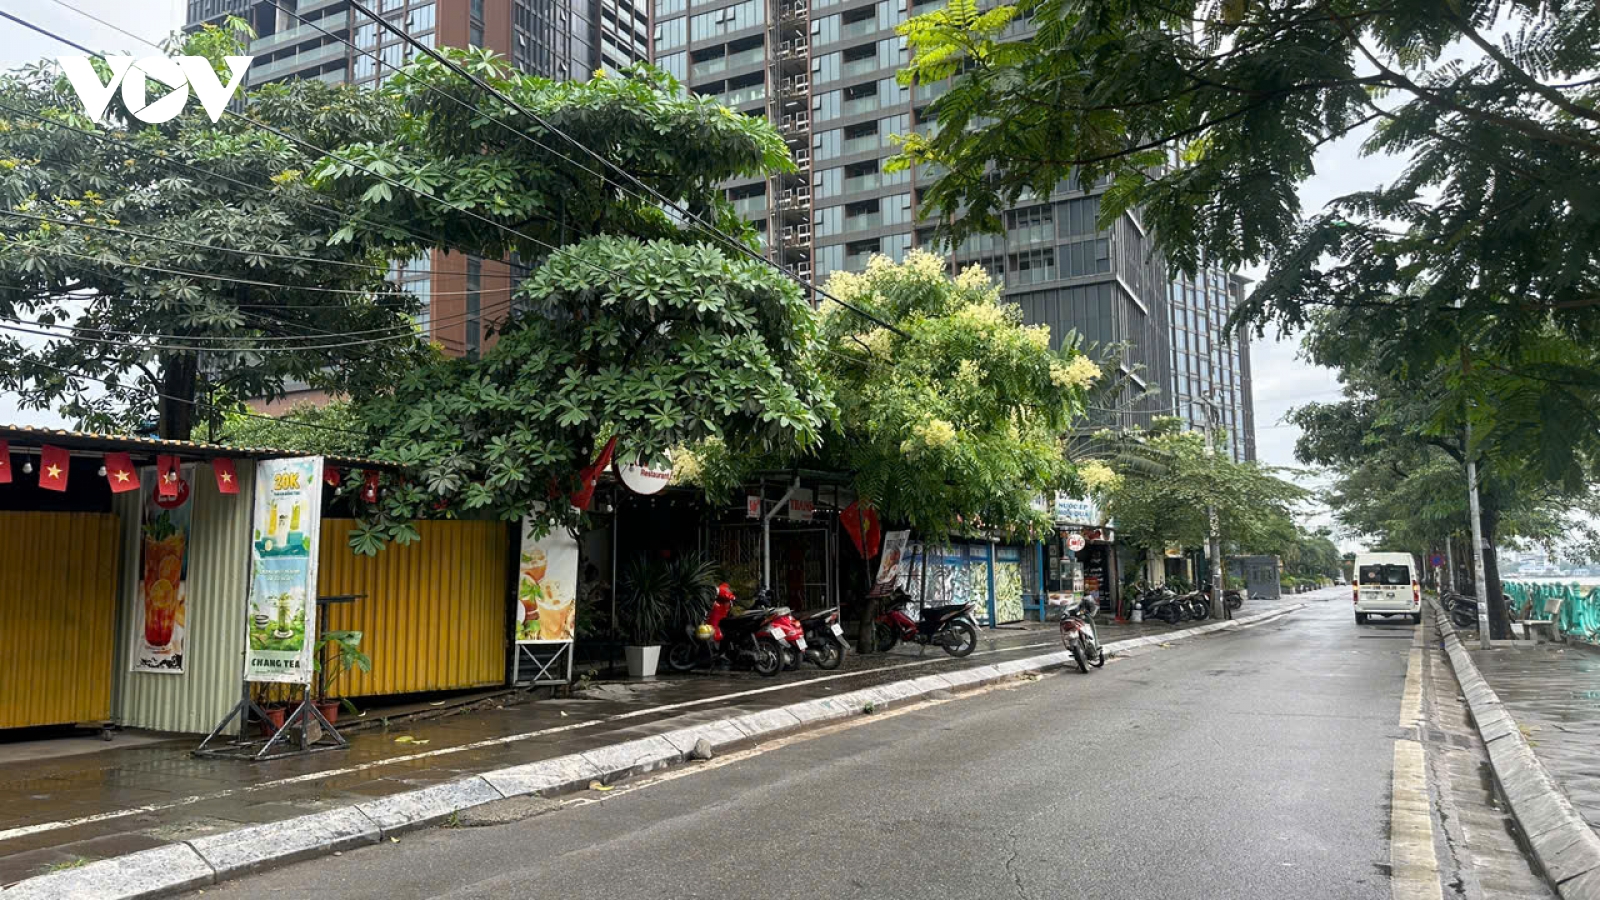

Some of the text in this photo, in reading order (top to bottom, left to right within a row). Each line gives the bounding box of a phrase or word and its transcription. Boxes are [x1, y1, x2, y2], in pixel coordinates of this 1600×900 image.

[274, 472, 301, 490] 20K
[251, 658, 301, 669] CHANG TEA
